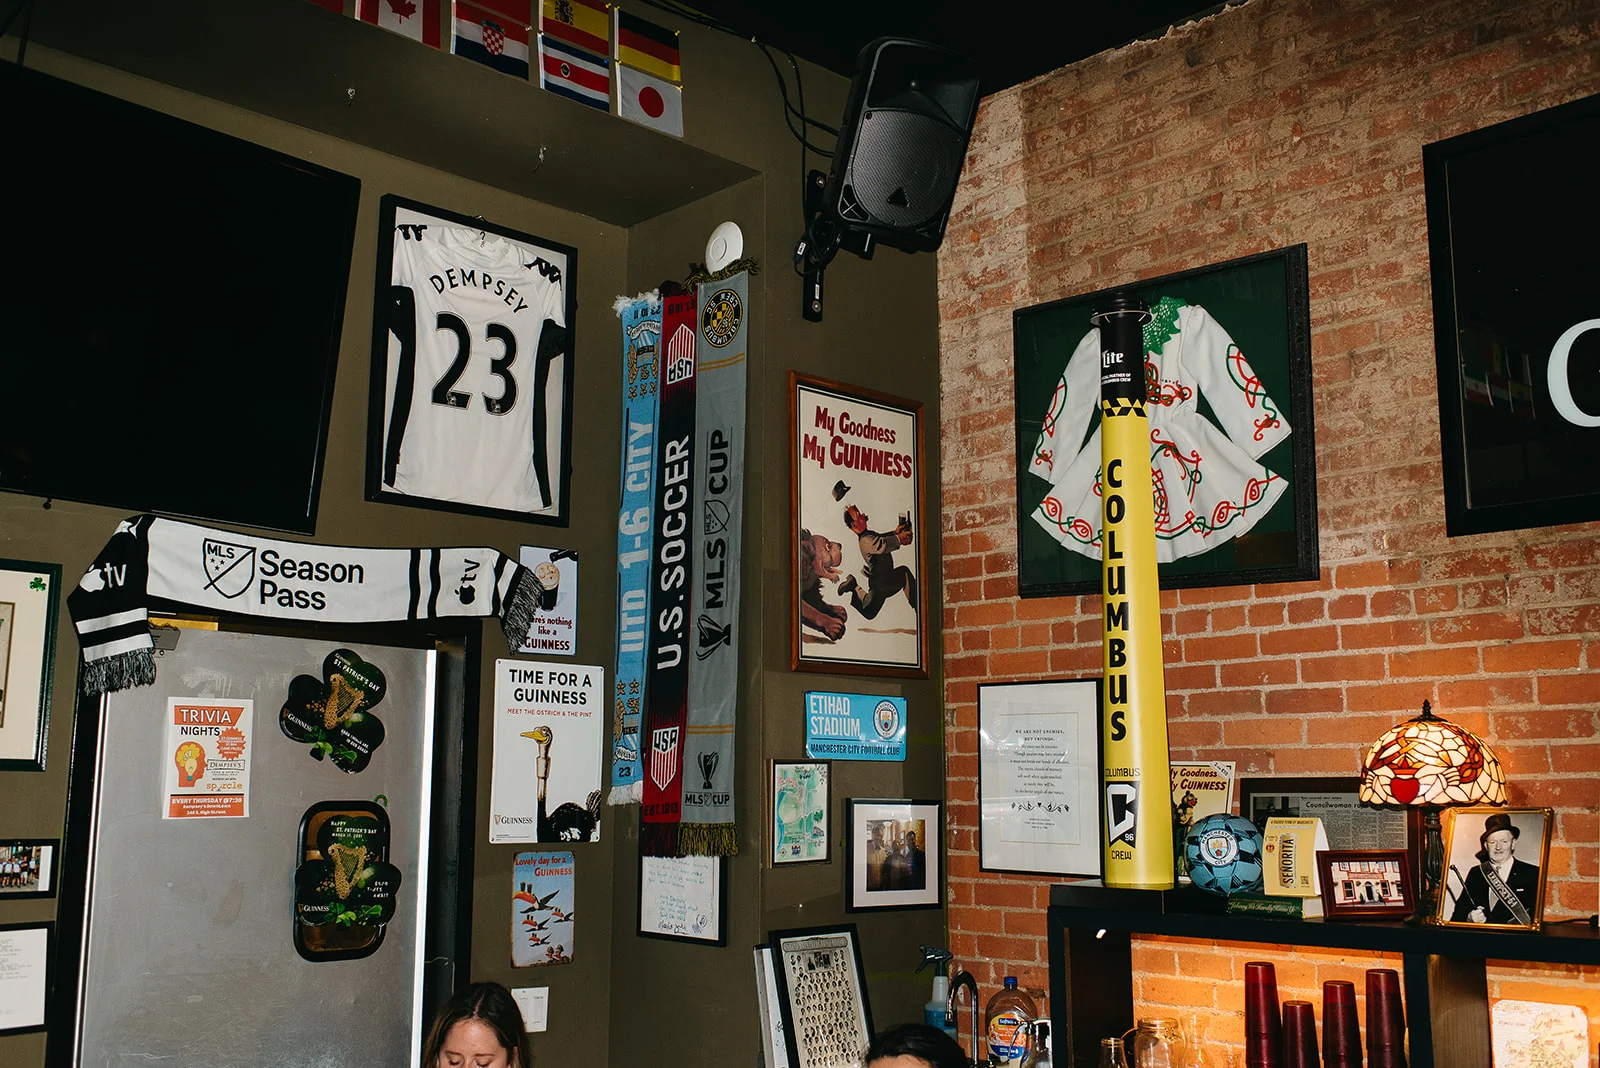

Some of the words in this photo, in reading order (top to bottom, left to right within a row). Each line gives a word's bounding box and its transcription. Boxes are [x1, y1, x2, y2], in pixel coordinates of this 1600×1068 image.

[429, 268, 528, 313] DEMPSEY
[704, 318, 739, 344] COLUMBUS
[431, 311, 519, 416] 23
[1102, 349, 1124, 368] Lite
[668, 359, 693, 383] USA
[815, 405, 835, 437] My
[839, 411, 896, 444] Goodness
[626, 421, 653, 493] CITY
[708, 429, 729, 495] CUP
[803, 433, 825, 469] My
[830, 435, 912, 479] GUINNESS
[660, 435, 689, 591] SOCCER
[619, 506, 650, 568] 1-6
[207, 544, 235, 559] MLS
[105, 562, 127, 588] tv
[260, 550, 364, 584] Season
[460, 559, 480, 582] tv
[706, 538, 726, 609] MLS
[260, 579, 326, 610] Pass
[1106, 458, 1130, 741] COLUMBUS
[538, 626, 551, 635] like
[547, 616, 572, 629] nothing
[621, 589, 646, 652] UTD
[524, 636, 570, 650] GUINNESS
[333, 659, 342, 669] ST.
[342, 664, 369, 685] PATRICK'S
[368, 680, 380, 692] DAY
[509, 669, 543, 684] TIME
[549, 672, 577, 686] FOR
[582, 674, 592, 688] A
[514, 688, 587, 705] GUINNESS
[810, 695, 850, 716] ETIHAD
[180, 708, 232, 723] TRIVIA
[288, 713, 313, 732] GUINNESS
[180, 726, 220, 736] NIGHTS
[810, 716, 861, 737] STADIUM
[653, 729, 677, 752] USA
[810, 744, 846, 754] MANCHESTER
[848, 745, 860, 754] CITY
[860, 745, 886, 755] FOOTBALL
[887, 746, 900, 756] CLUB
[1180, 768, 1218, 778] Goodness
[206, 782, 243, 792] sprcle
[1171, 781, 1178, 792] y
[1180, 779, 1227, 791] GUINNESS
[684, 794, 703, 805] MLS
[712, 794, 730, 804] CUP
[501, 816, 533, 825] GUINNESS
[1201, 830, 1234, 844] MANCHESTER
[516, 858, 537, 866] Lovely
[552, 856, 561, 864] for
[1112, 850, 1132, 860] CREW
[534, 868, 573, 876] GUINNESS
[304, 904, 330, 912] GUINNESS
